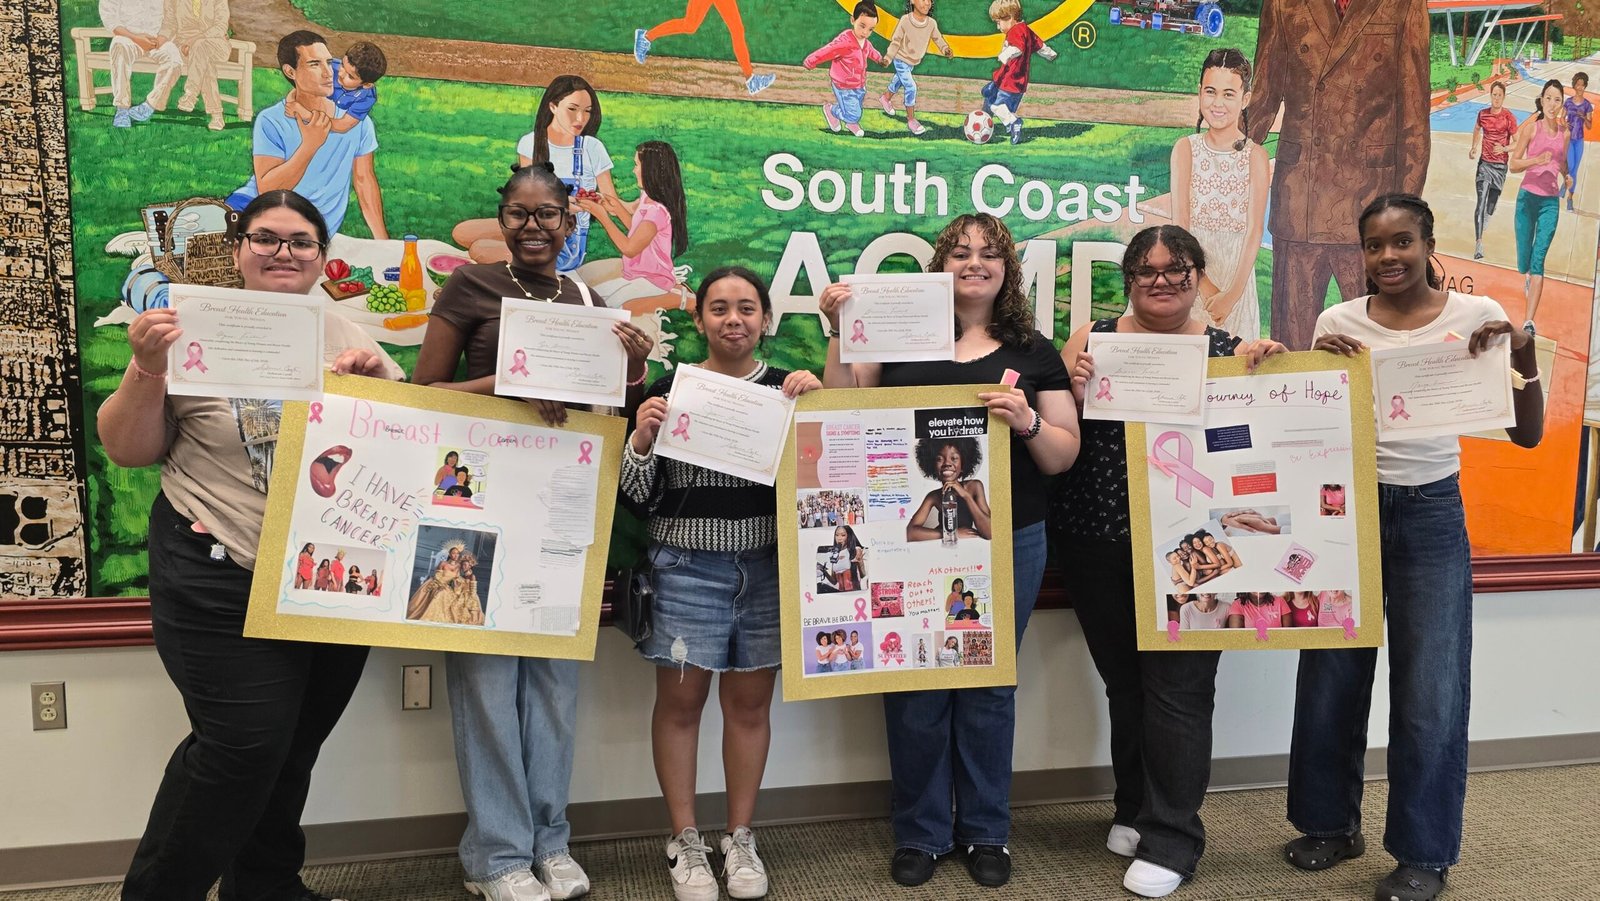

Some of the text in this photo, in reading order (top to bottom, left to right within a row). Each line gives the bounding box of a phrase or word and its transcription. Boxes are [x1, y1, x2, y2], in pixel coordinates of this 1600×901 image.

[761, 152, 1145, 224] South Coast
[860, 285, 925, 295] Breast Health Education
[200, 303, 287, 318] Breast Health Education
[526, 315, 546, 325] Breast
[547, 316, 570, 328] Health
[570, 319, 599, 330] Education
[1110, 345, 1178, 355] Breast Health Education
[1397, 360, 1420, 370] Breast
[1420, 356, 1444, 367] Health
[1206, 386, 1256, 407] ourney
[1269, 384, 1297, 404] of
[1305, 379, 1343, 405] Hope
[349, 399, 559, 450] Breast Cancer
[928, 415, 985, 428] elevate how
[929, 425, 984, 439] you hydrate
[349, 464, 416, 512] I HAVE
[336, 489, 399, 532] BREAST
[320, 507, 381, 547] CANCER
[907, 578, 933, 589] Reach
